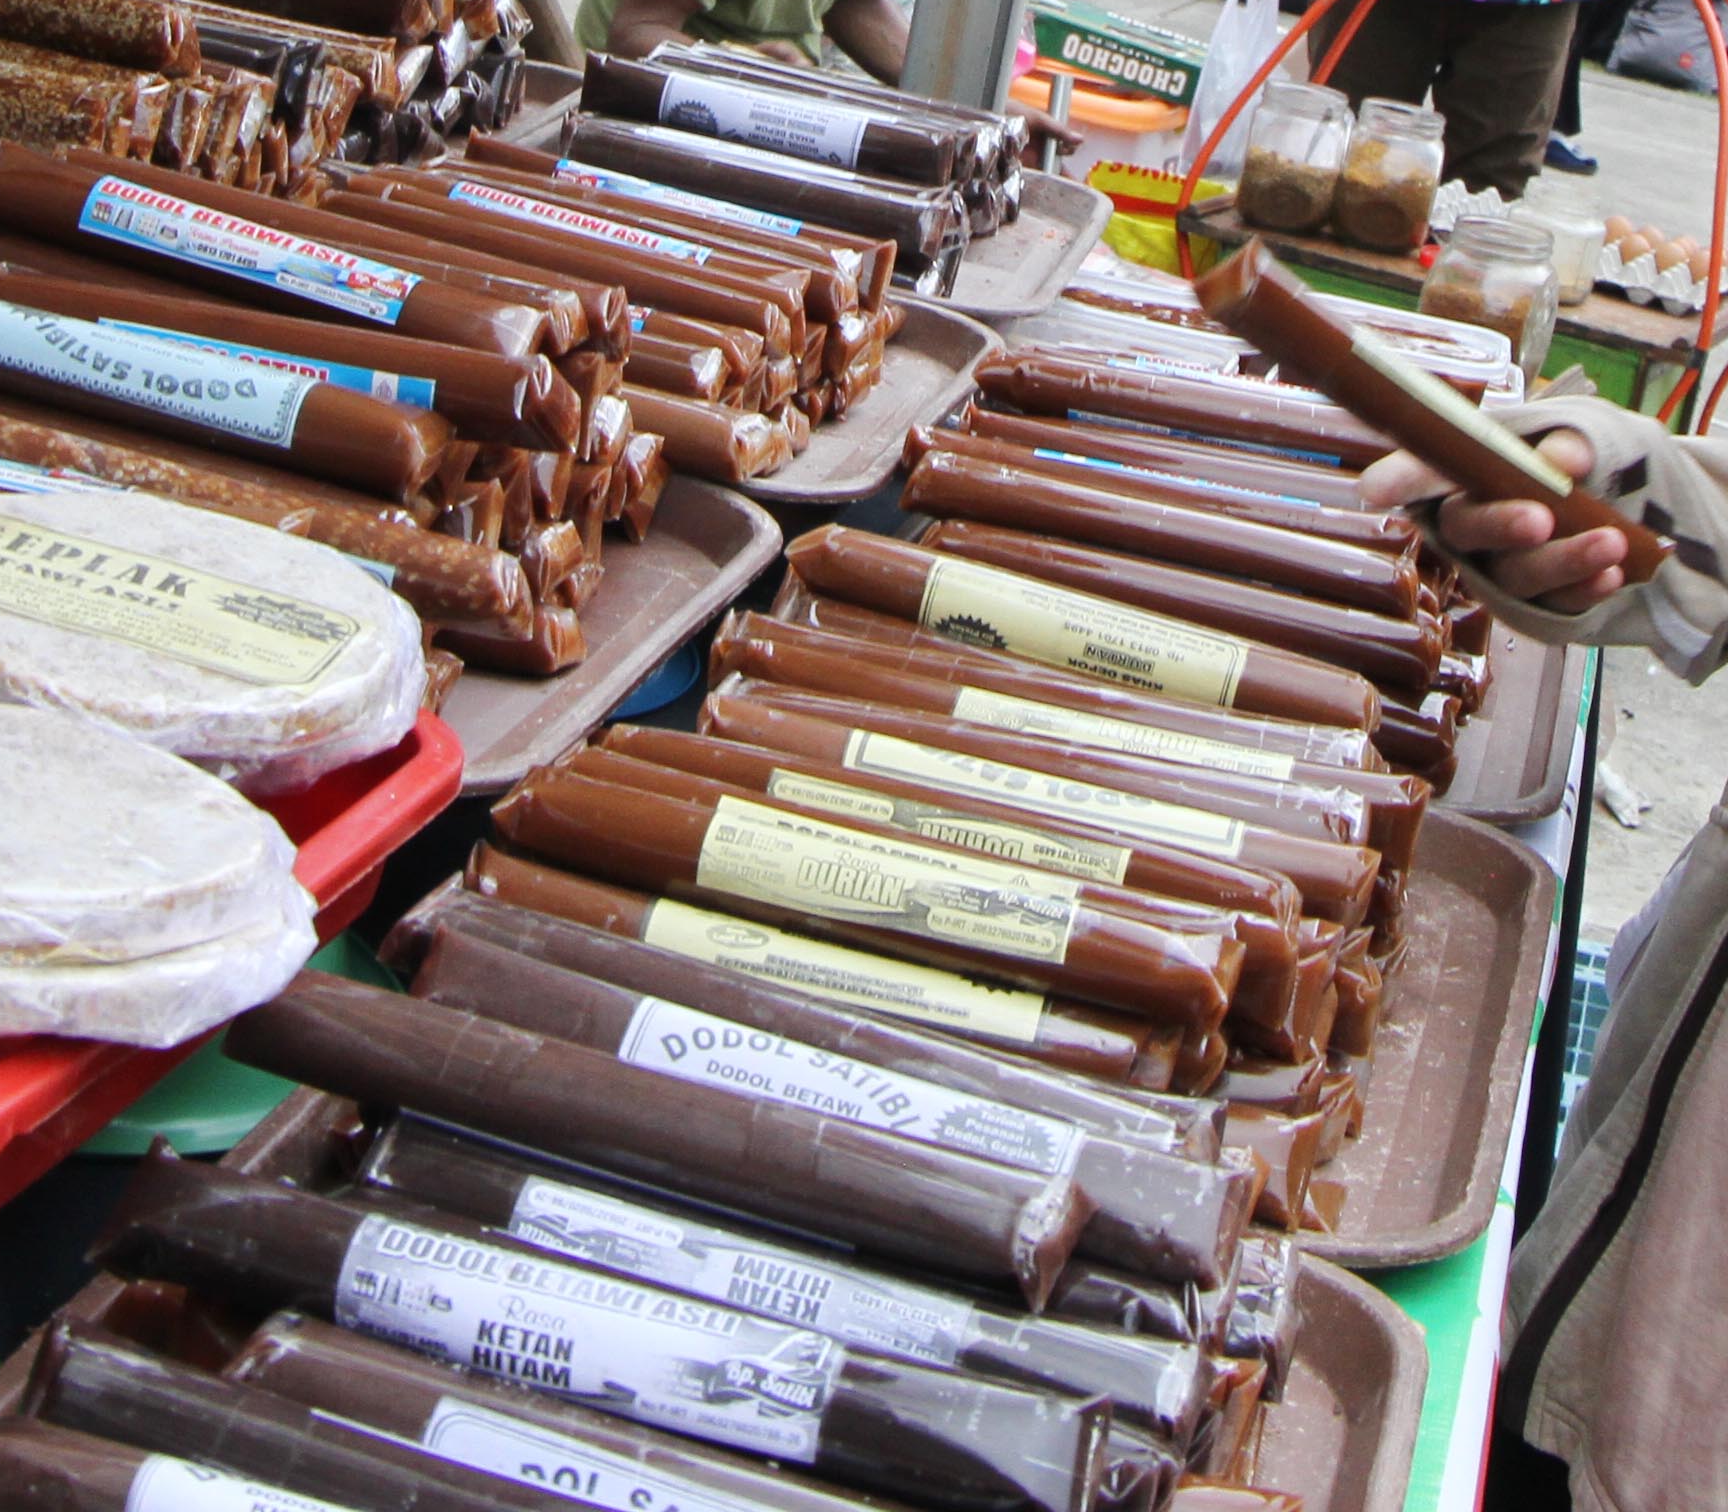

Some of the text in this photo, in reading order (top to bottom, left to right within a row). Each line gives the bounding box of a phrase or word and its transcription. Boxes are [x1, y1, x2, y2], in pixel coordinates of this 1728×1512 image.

[1060, 31, 1188, 97] CHOOCHOO
[98, 178, 360, 271] DODOL BETAWI ASLI
[460, 181, 528, 211] DODOL
[529, 202, 612, 237] BETAWI
[611, 226, 660, 251] ASLI
[31, 318, 133, 384] SATIBI
[134, 366, 261, 403] DODOL
[93, 584, 181, 612] ASLI
[797, 856, 907, 911] DURIAN
[653, 1029, 923, 1136] DODOL SATIBI
[703, 1057, 865, 1121] DODOL BETAWI
[941, 1124, 990, 1151] Dodol,
[380, 1223, 501, 1278] DODOL
[504, 1258, 648, 1317] BETAWI
[648, 1297, 739, 1336] ASLI
[723, 1274, 823, 1325] KETAN
[730, 1252, 832, 1300] HITAM
[494, 1292, 571, 1333] Rasa
[468, 1343, 575, 1389] HITAM
[473, 1317, 577, 1365] KETAN
[757, 1371, 819, 1409] Satibi
